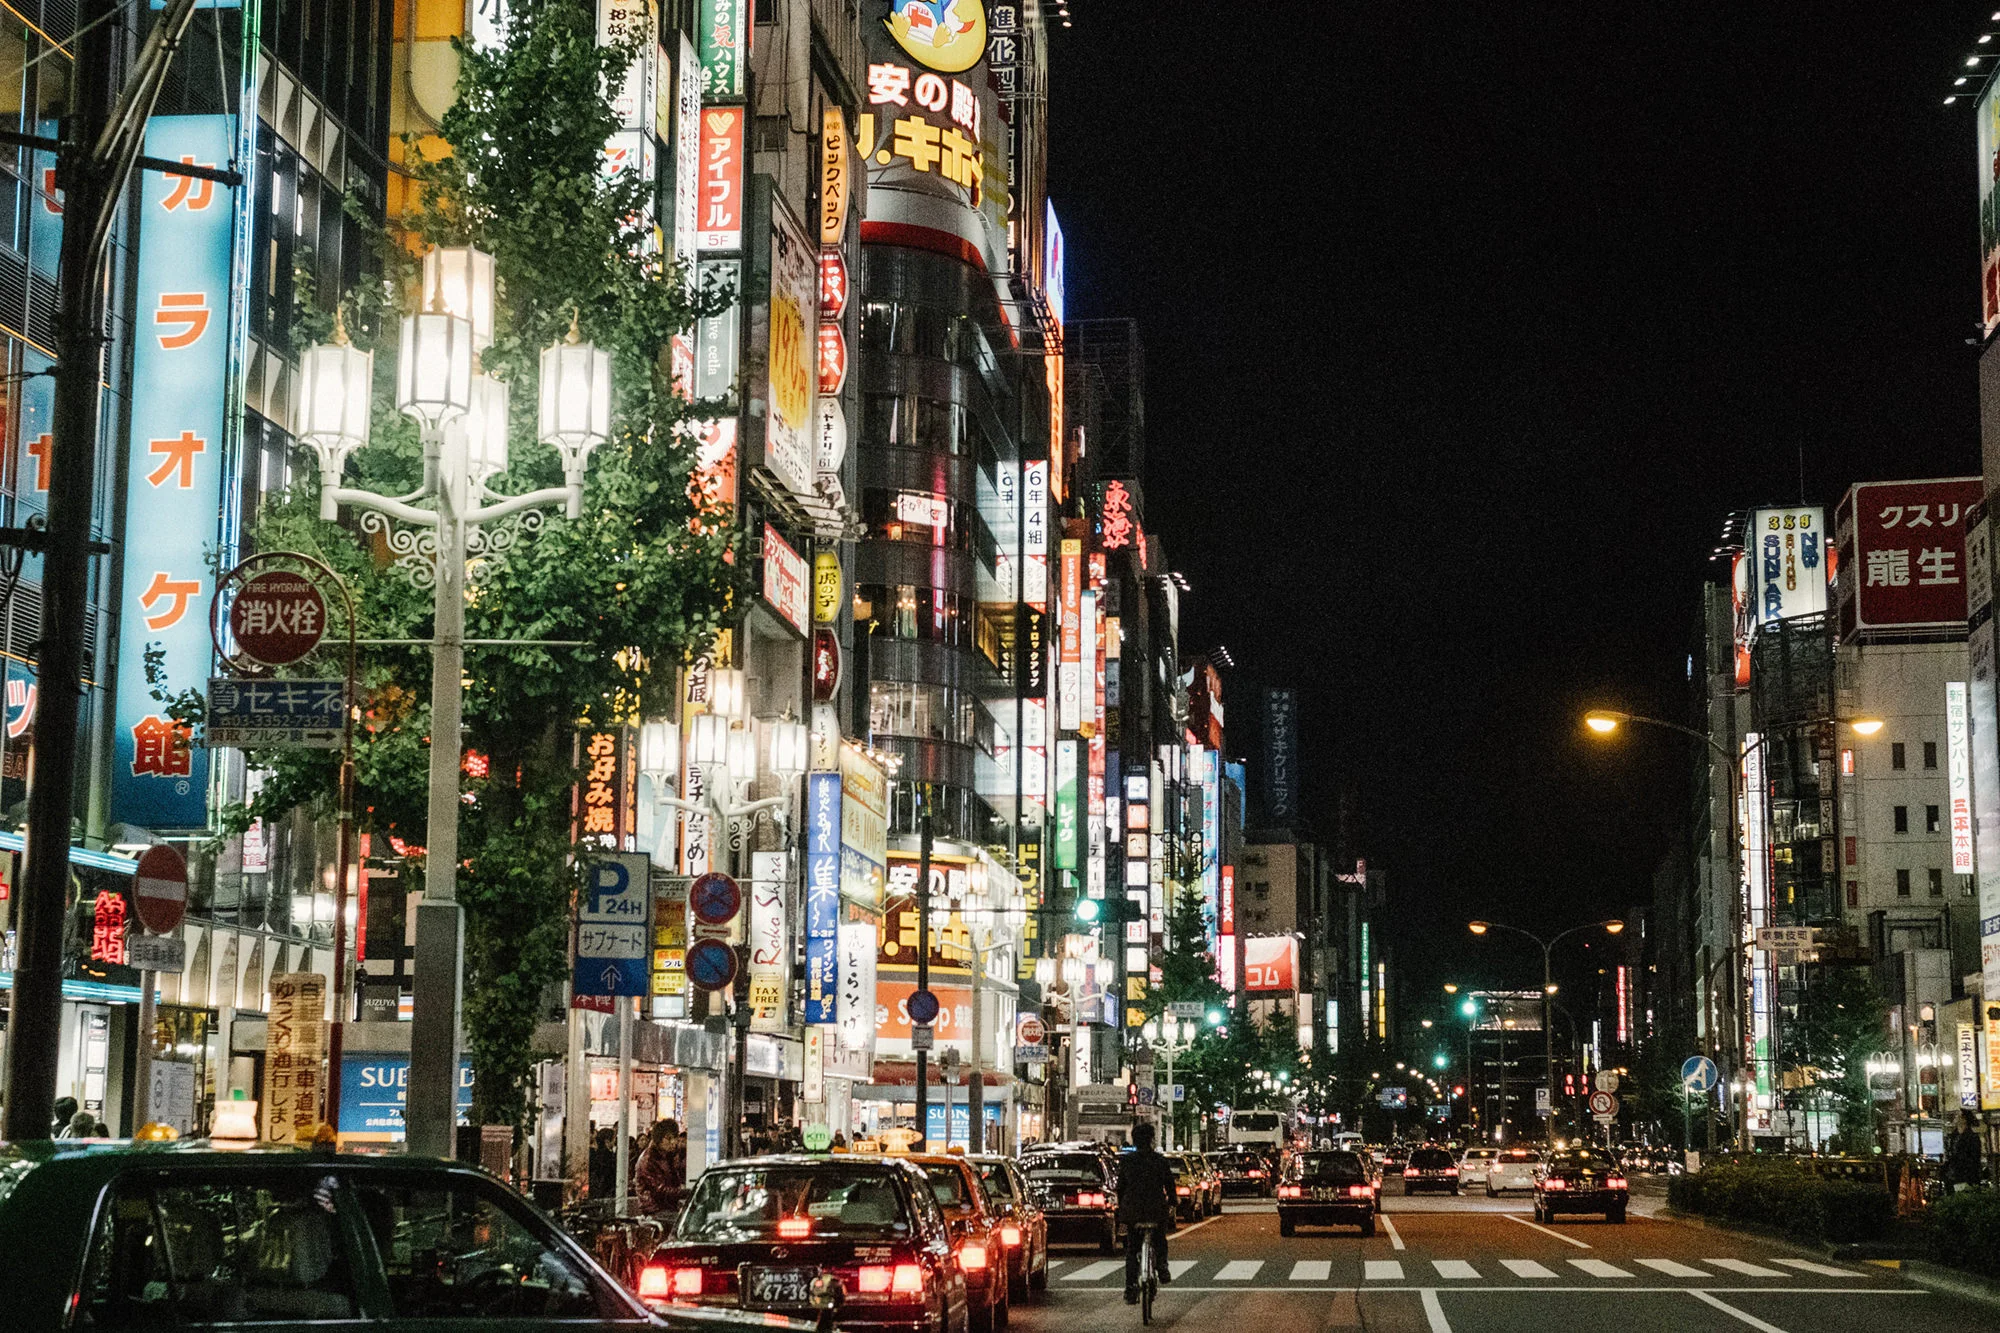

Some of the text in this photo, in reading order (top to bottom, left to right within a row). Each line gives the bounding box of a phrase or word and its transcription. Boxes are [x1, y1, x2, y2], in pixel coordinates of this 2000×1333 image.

[707, 138, 731, 228] アイフル
[708, 234, 729, 246] 5F
[708, 345, 720, 376] cella
[130, 154, 216, 778] カラオケ館
[1028, 471, 1043, 544] 6年4組
[1880, 503, 1973, 529] クスリ
[1867, 547, 1959, 587] 龍生
[247, 584, 310, 593] FIRE HYDRANT
[818, 572, 837, 607] 虎の子
[239, 600, 320, 635] 消火栓
[244, 683, 342, 713] セキネ
[585, 732, 616, 832] お好み焼
[1060, 804, 1073, 842] レイク
[1953, 799, 1970, 866] 三平本館
[588, 862, 629, 913] P
[1223, 875, 1233, 922] SHIDAX
[605, 899, 641, 914] 24H
[581, 926, 643, 950] サブナード
[823, 940, 834, 983] ワインと
[1248, 967, 1280, 987] コム
[364, 999, 396, 1007] SUZUYA
[755, 987, 779, 995] TAX
[1538, 1091, 1546, 1101] P
[763, 1283, 808, 1300] 67-36
